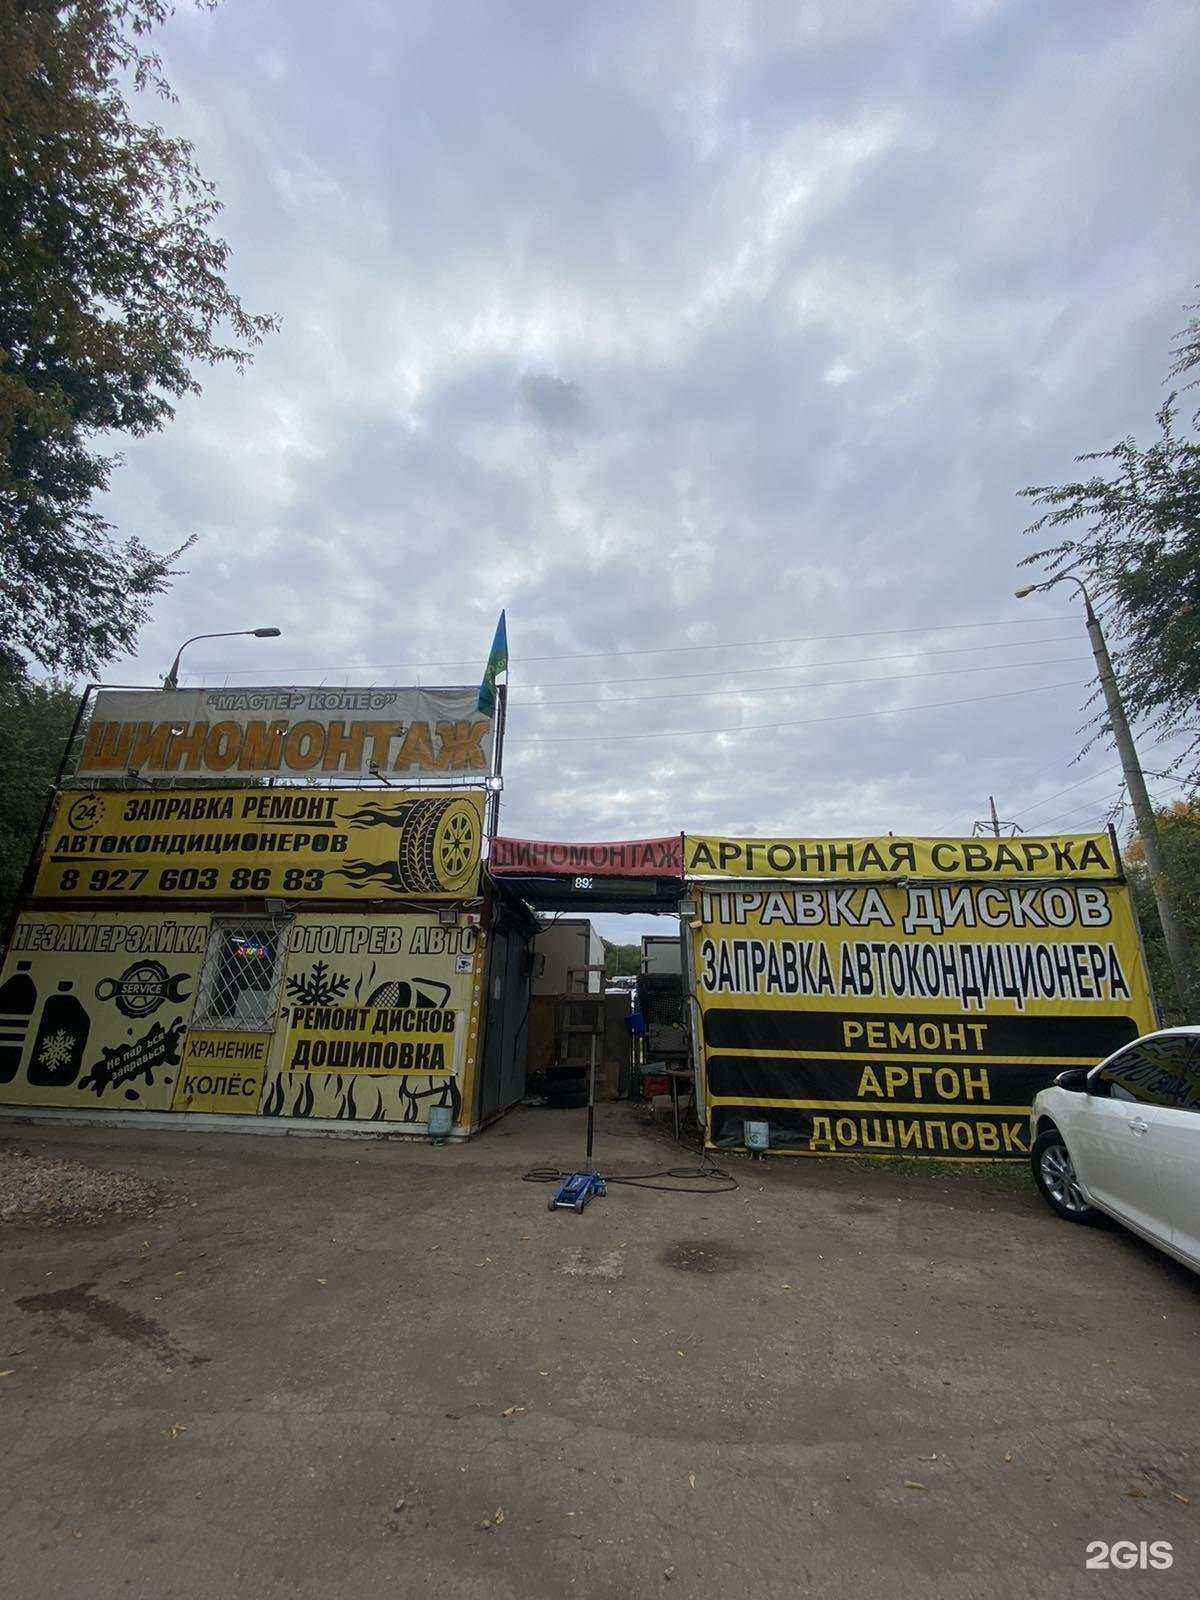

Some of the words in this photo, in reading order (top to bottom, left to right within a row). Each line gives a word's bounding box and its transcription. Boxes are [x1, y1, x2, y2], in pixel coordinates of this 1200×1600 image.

[79, 721, 492, 772] ШИНОМОНТАЖ
[75, 805, 97, 820] 24
[123, 798, 234, 822] ЗАПРАВКА
[241, 796, 339, 821] РЕМОНТ
[54, 834, 349, 855] АВТОКОНДИЦИОНЕРОВ
[494, 842, 681, 868] ШИНОМОНТАЖ
[689, 839, 917, 872] АРГОННАЯ
[931, 839, 1111, 872] СВАРКА
[59, 869, 80, 891] 8
[88, 869, 149, 892] 927
[158, 869, 219, 891] 603
[229, 868, 272, 891] 86
[282, 867, 325, 891] 83
[701, 887, 893, 926] ПРАВКА
[901, 887, 1112, 936] ДИСКОВ
[11, 921, 208, 954] НЕЗАМЕРЗАЙКА
[288, 925, 403, 955] ОТОГРЕВ
[409, 926, 477, 955] АВТО
[121, 984, 162, 994] SERVICE
[701, 938, 837, 996] ЗАПРАВКА
[838, 941, 1132, 1012] АВТОКОНДИЦИОНЕРА
[291, 1008, 370, 1031] РЕМОНТ
[371, 1009, 456, 1035] ДИСКОВ
[842, 1020, 990, 1051] РЕМОНТ
[187, 1039, 264, 1060] ХРАНЕНИЕ
[290, 1039, 446, 1071] ДОШИПОВКА
[182, 1072, 257, 1097] КОЛЁС
[856, 1064, 992, 1101] АРГОН
[808, 1116, 1030, 1152] ДОШИПОВК
